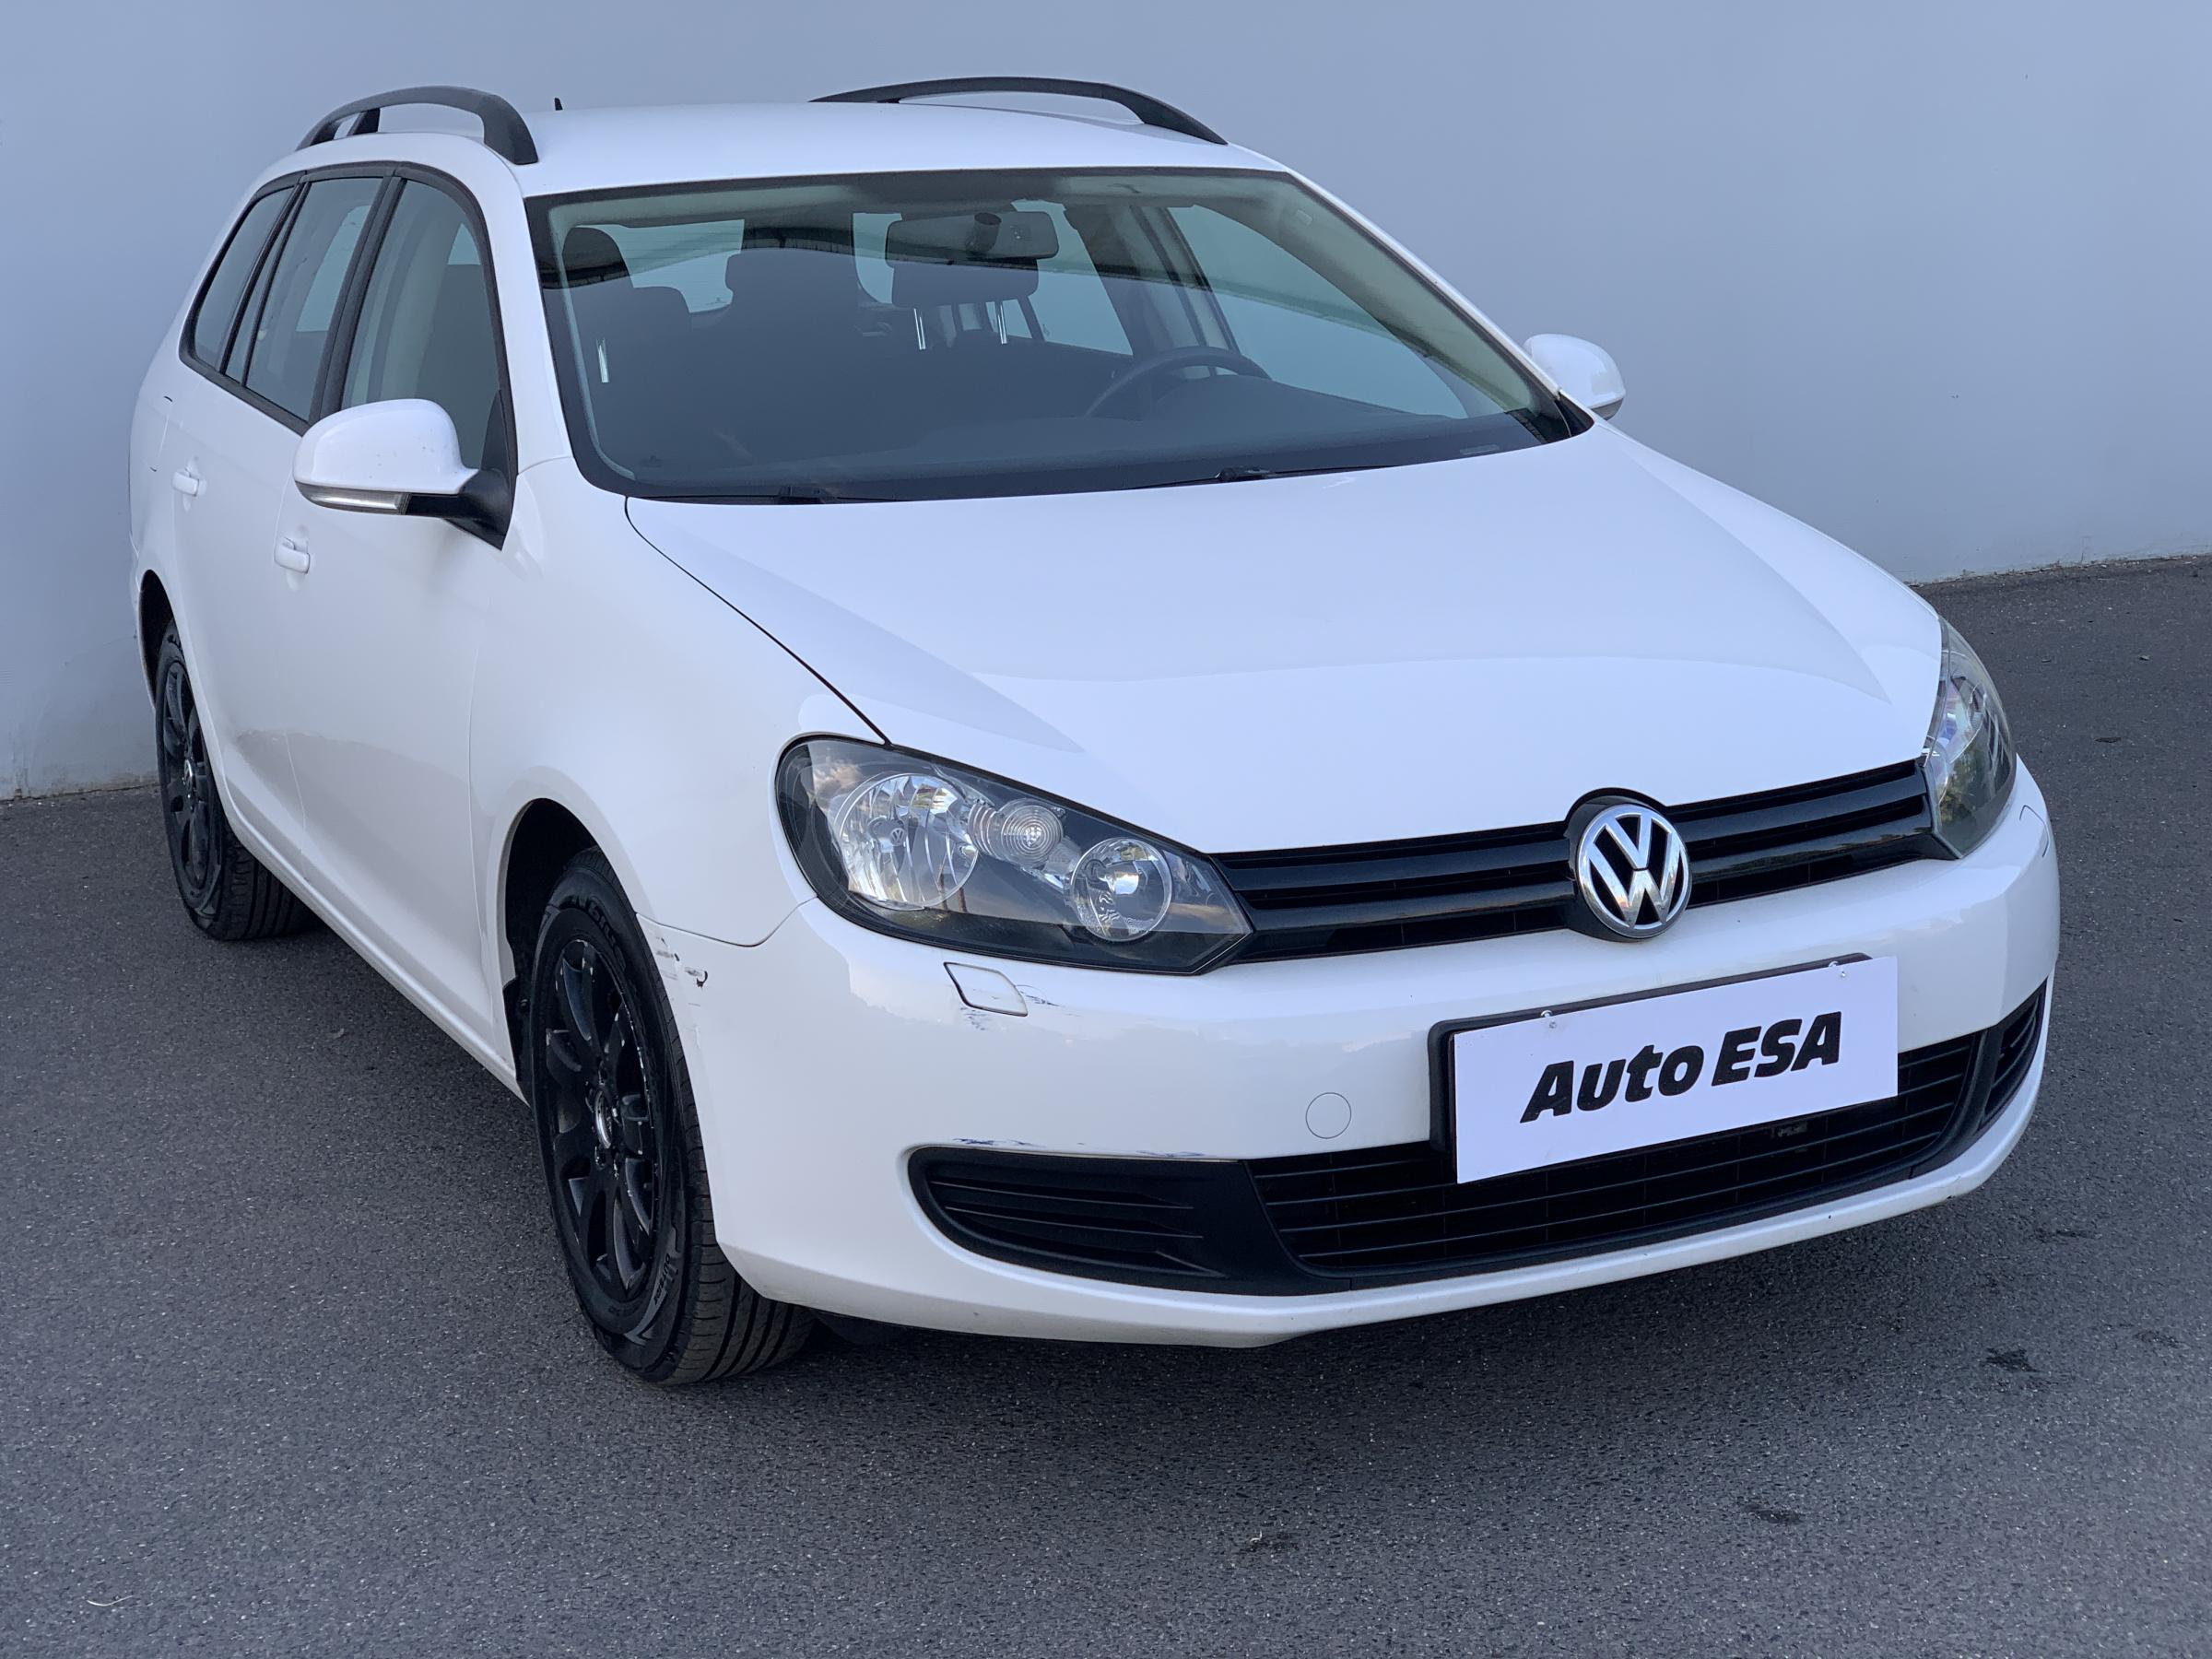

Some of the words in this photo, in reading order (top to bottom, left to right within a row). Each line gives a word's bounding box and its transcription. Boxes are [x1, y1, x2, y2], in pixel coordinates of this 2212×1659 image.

[1585, 811, 1686, 929] VW
[1520, 1044, 1704, 1124] Auto
[1711, 1011, 1841, 1086] ESA
